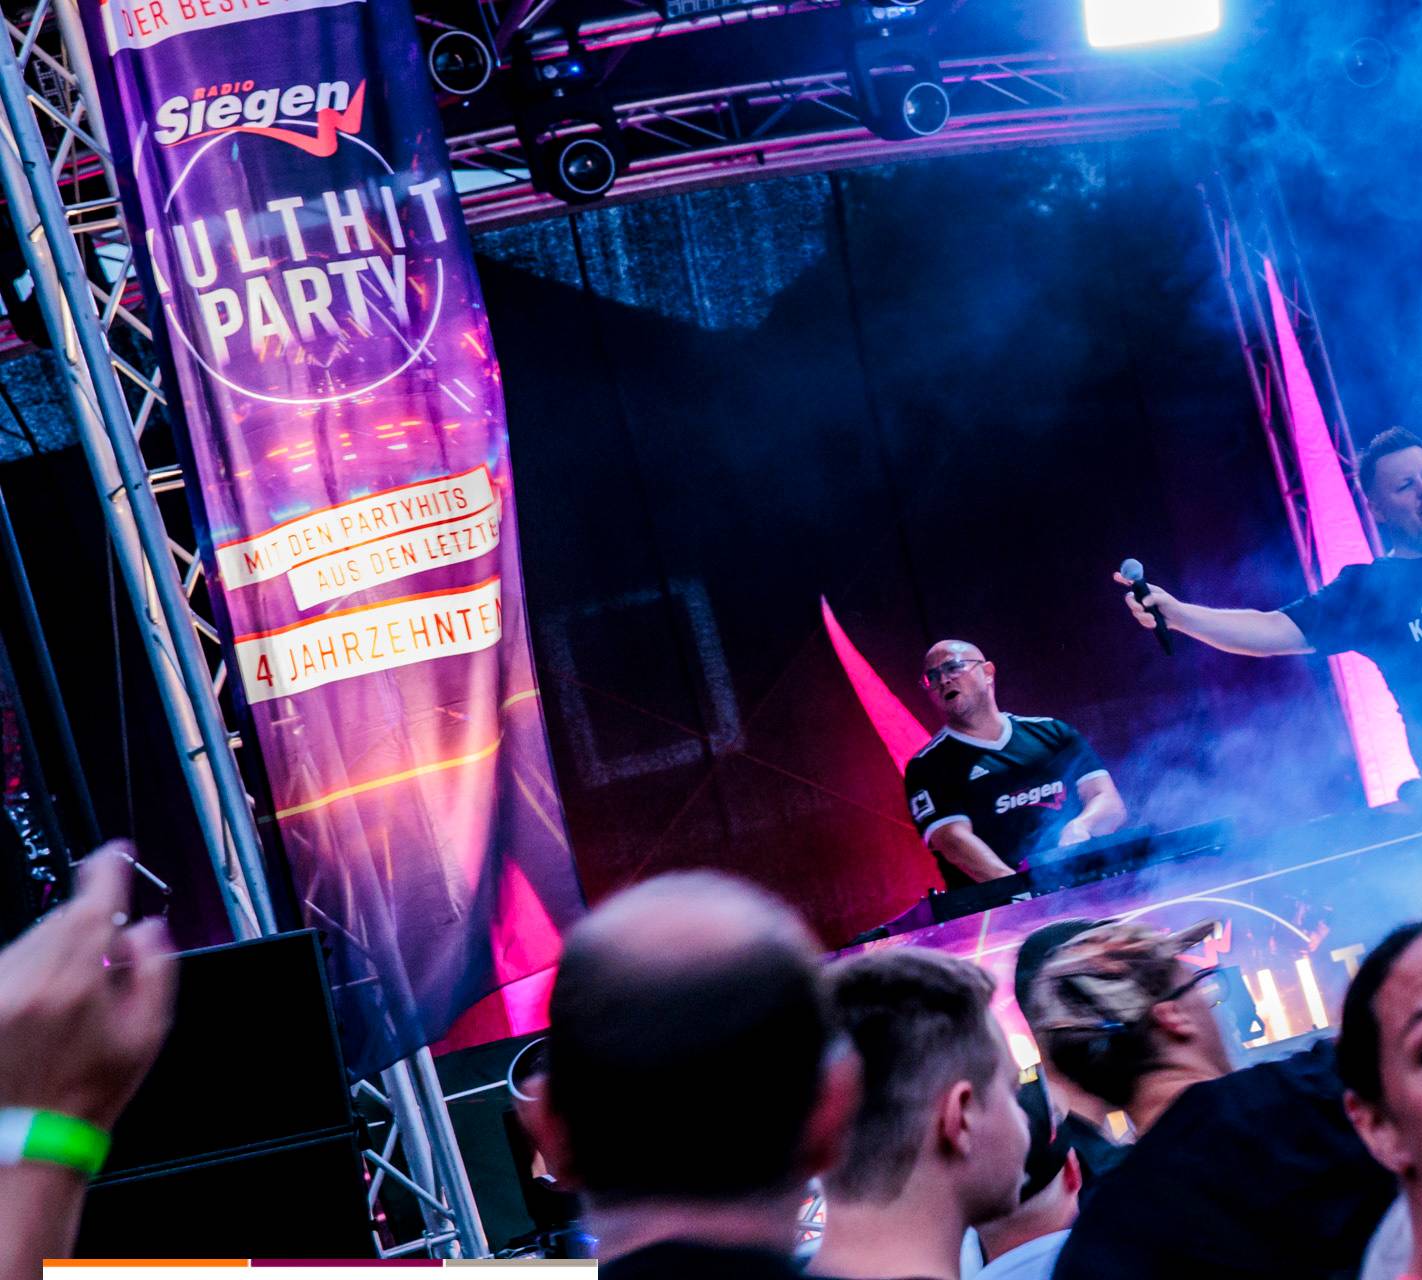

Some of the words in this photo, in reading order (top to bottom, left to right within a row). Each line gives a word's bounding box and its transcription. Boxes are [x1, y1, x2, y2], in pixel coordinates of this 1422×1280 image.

[178, 0, 270, 20] BES
[154, 80, 350, 145] Siegen
[192, 80, 254, 100] RADIO
[199, 255, 411, 367] PARTY
[244, 542, 282, 575] MIT
[287, 522, 334, 557] DEN
[340, 487, 468, 538] PARTYHITS
[317, 559, 362, 592] AUS
[369, 542, 417, 575] DEN
[423, 516, 499, 560] LETZTE
[256, 653, 274, 688] 4
[995, 780, 1063, 814] Siegen
